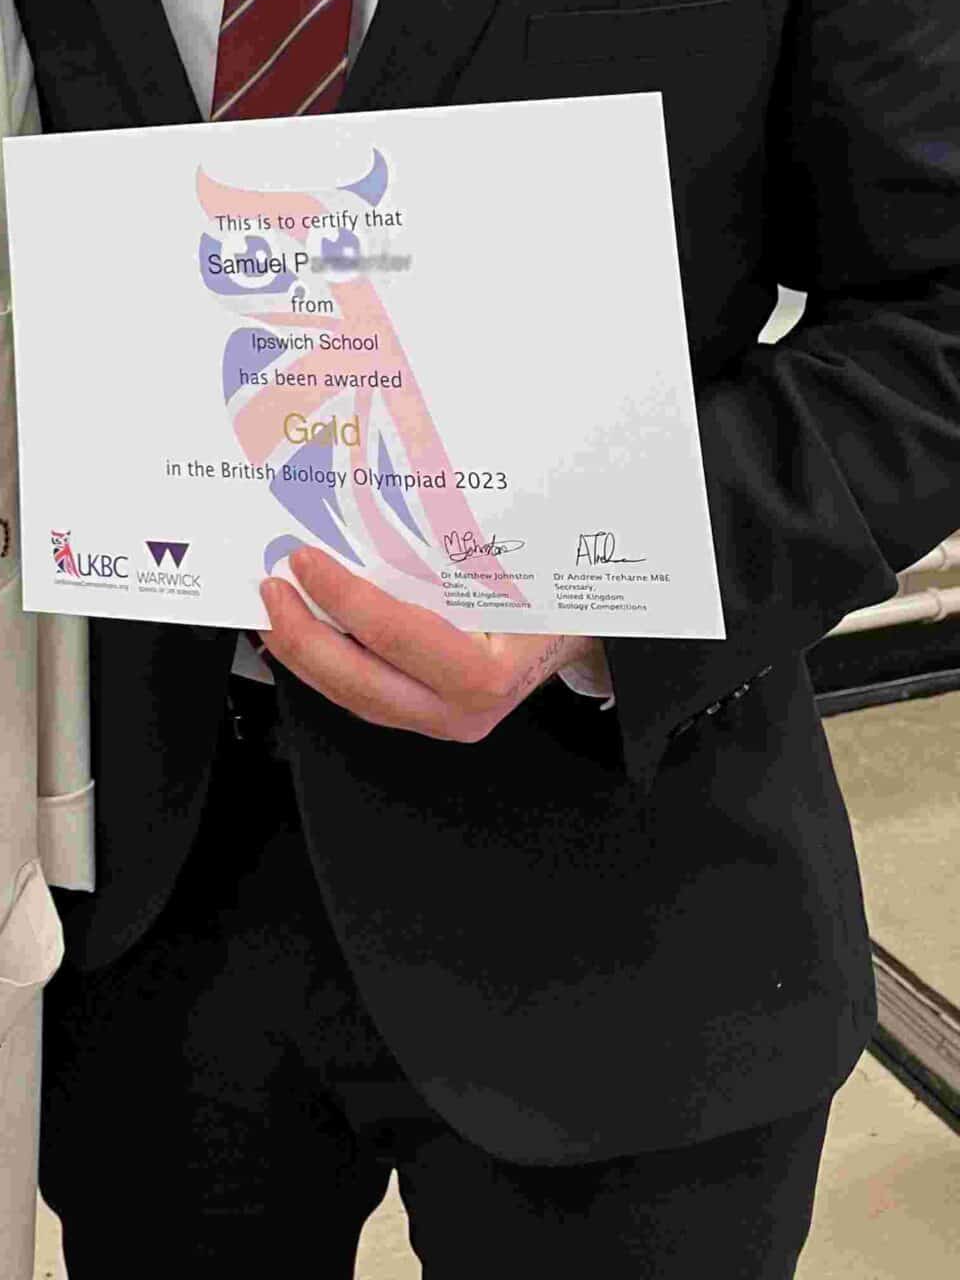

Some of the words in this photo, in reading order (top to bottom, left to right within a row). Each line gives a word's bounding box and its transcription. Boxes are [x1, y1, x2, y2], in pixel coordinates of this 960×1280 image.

[215, 215, 251, 231] This
[257, 213, 271, 231] is
[278, 215, 295, 230] to
[301, 210, 358, 232] certify
[365, 209, 402, 228] that
[207, 253, 287, 274] Samuel
[291, 296, 333, 313] from
[251, 332, 313, 352] Ipswich
[319, 333, 379, 351] School
[240, 368, 268, 386] has
[276, 369, 317, 387] been
[324, 371, 402, 388] awarded
[283, 413, 361, 447] Gold
[166, 459, 181, 476] in
[187, 460, 215, 478] the
[221, 461, 275, 482] British
[282, 464, 346, 488] Biology
[353, 467, 446, 491] Olympiad
[454, 471, 508, 490] 2023
[77, 553, 129, 578] UKBC
[136, 571, 201, 588] WARWICK
[441, 572, 452, 580] Dr
[454, 572, 492, 580] Matthew
[494, 572, 535, 581] Johnston
[553, 573, 564, 581] Dr
[567, 573, 603, 581] Andrew
[606, 573, 649, 582] Treharne
[651, 574, 671, 582] MBE
[446, 599, 475, 609] Biology
[477, 600, 532, 609] Competitions
[473, 591, 509, 601] Kingdom
[586, 593, 624, 602] Kingdom
[558, 602, 588, 612] Biology
[590, 602, 647, 612] Competitions
